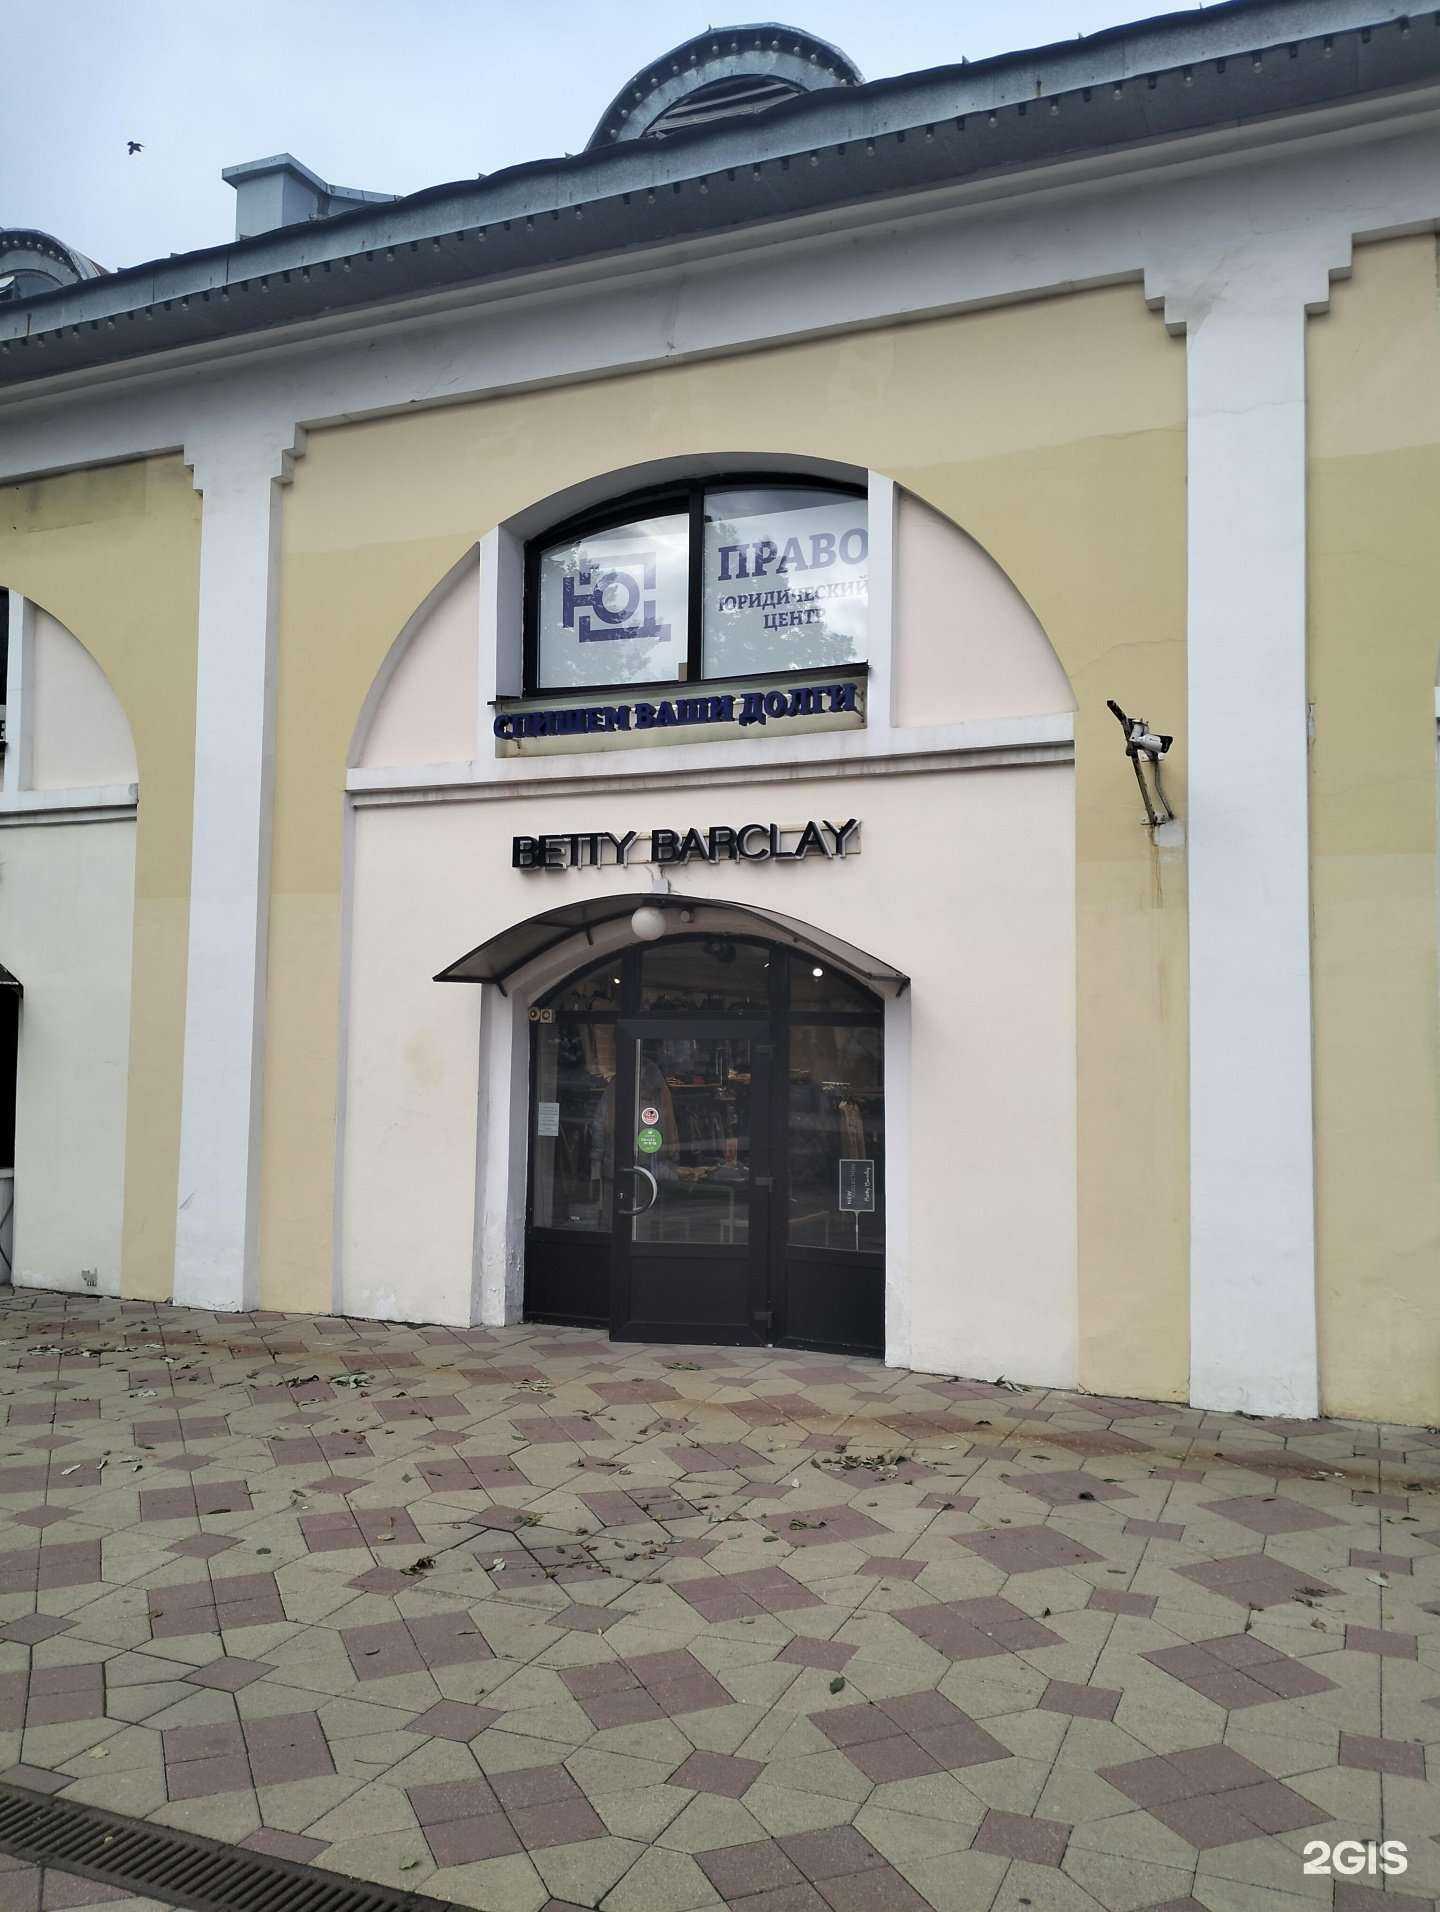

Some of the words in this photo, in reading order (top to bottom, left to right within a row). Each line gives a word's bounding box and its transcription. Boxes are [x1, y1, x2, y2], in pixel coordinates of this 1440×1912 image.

[717, 527, 869, 581] ПРАВО
[494, 705, 632, 740] СПИШЕМ
[635, 694, 735, 730] ВАШИ
[738, 683, 858, 726] ДОЛГИ
[512, 830, 637, 870] BETTY
[651, 818, 861, 865] BARCLAY
